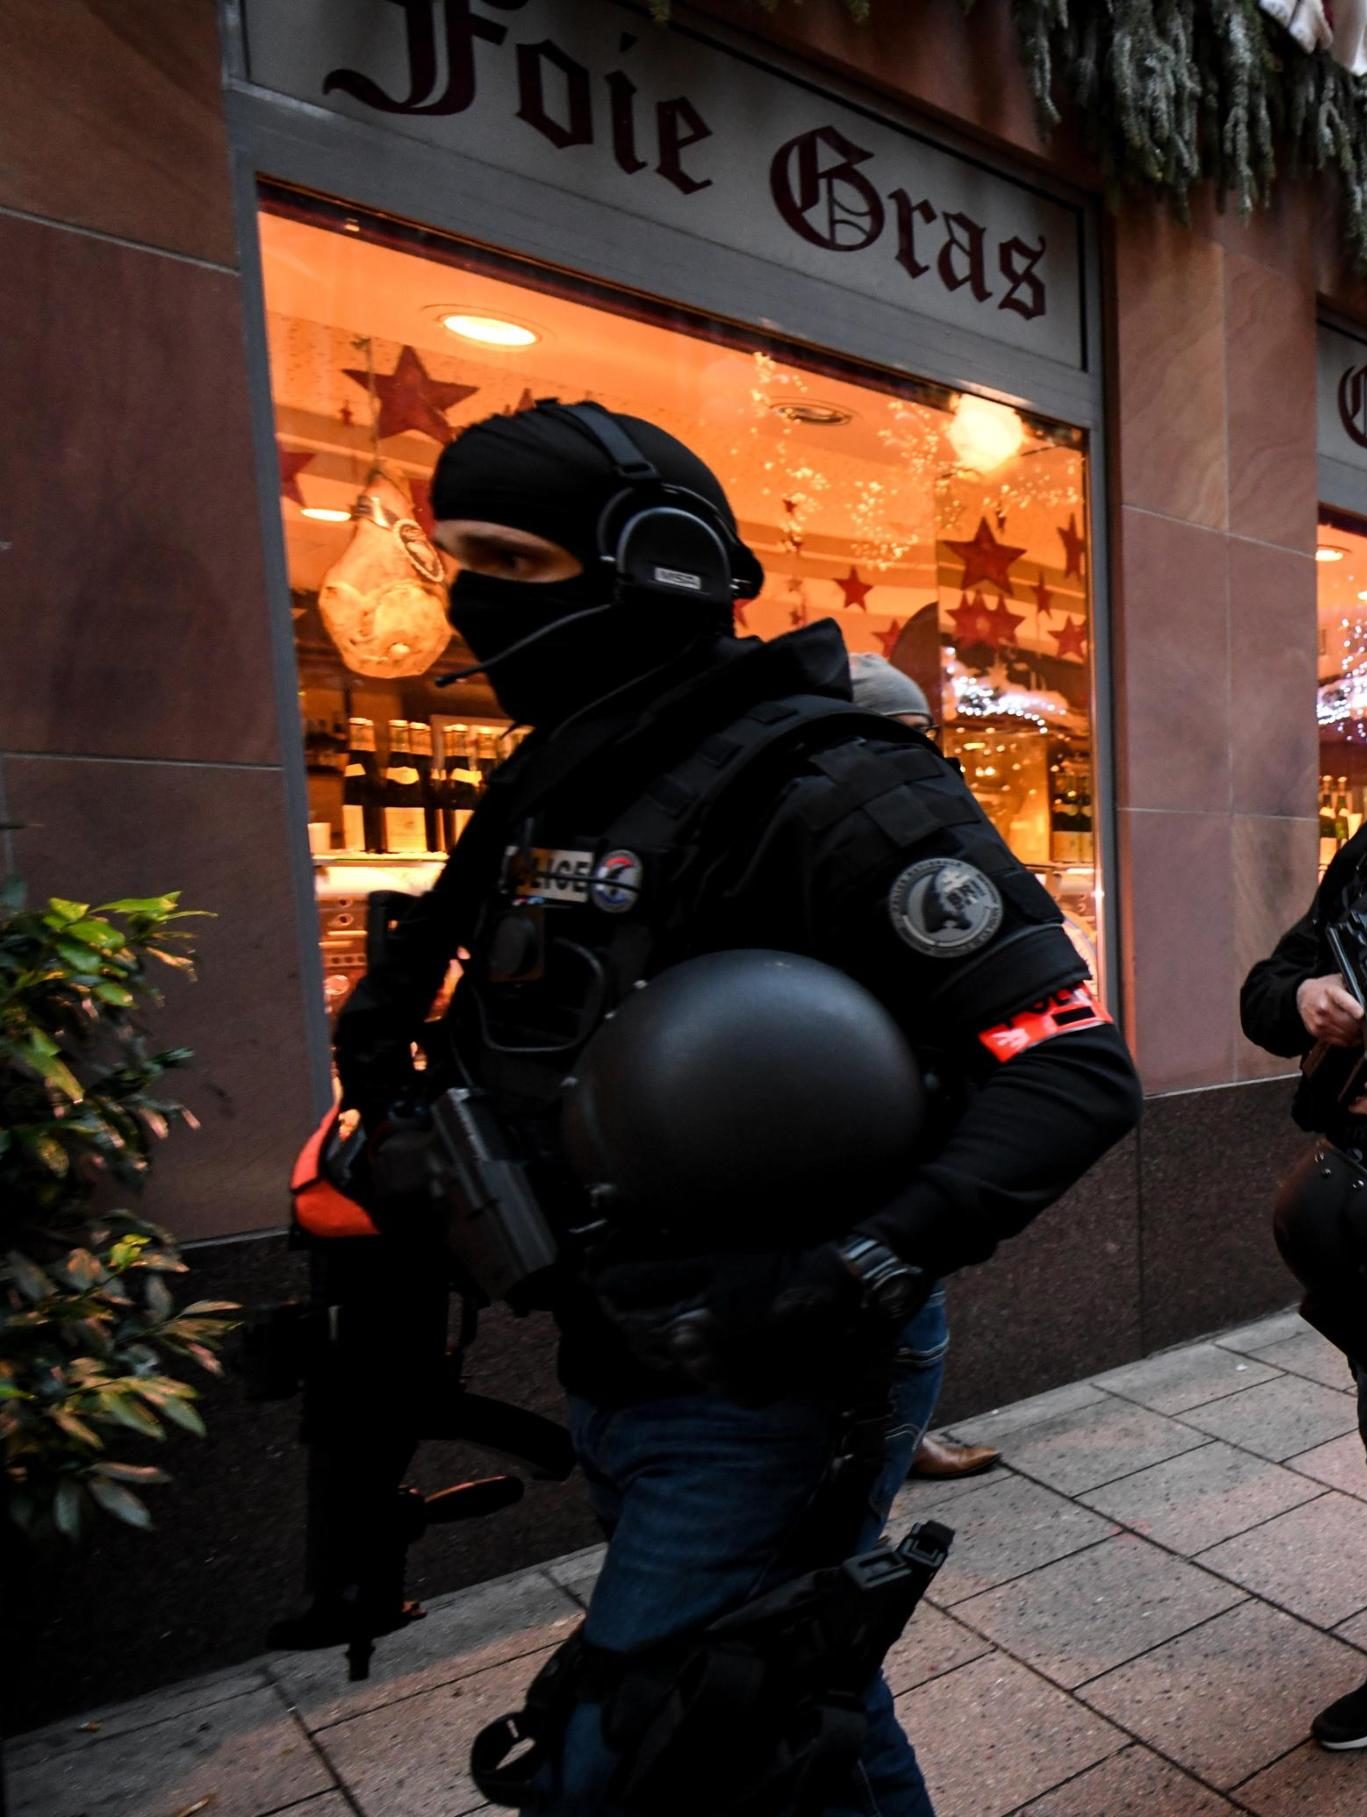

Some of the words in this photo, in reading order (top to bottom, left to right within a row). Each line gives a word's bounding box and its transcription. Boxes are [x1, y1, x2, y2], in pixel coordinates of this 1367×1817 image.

[323, 0, 713, 195] Foie
[770, 125, 1047, 320] Gras
[514, 854, 590, 893] LICE
